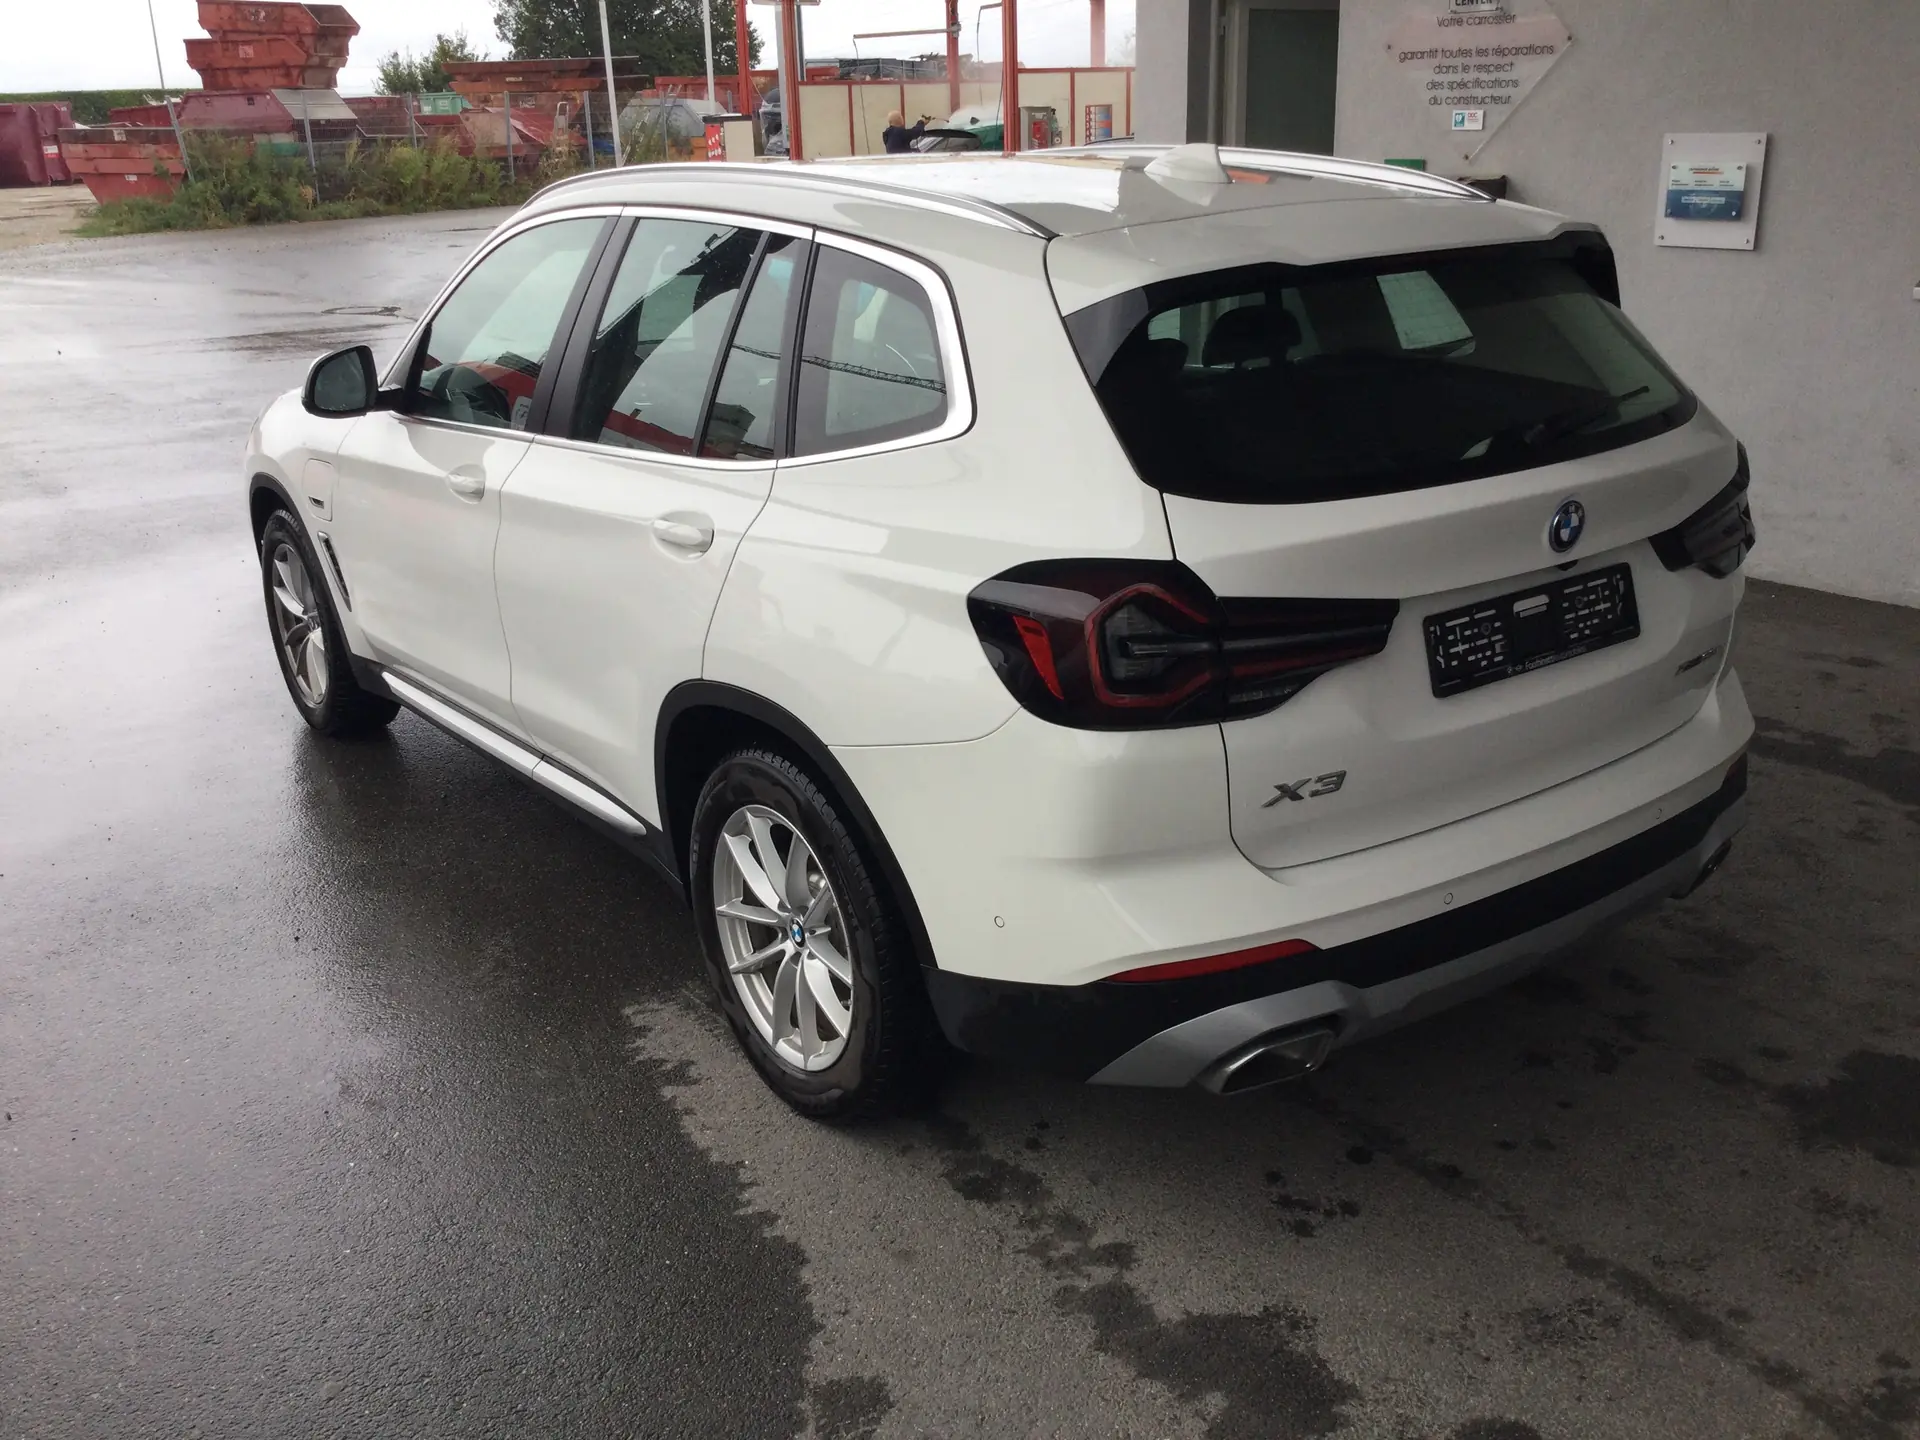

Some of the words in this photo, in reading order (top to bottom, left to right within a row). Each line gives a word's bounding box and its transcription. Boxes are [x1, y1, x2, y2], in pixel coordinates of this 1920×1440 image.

[1436, 16, 1464, 28] Votre
[1465, 12, 1517, 27] carrossier
[1398, 48, 1439, 63] garantit
[1440, 47, 1473, 59] toutes
[1475, 46, 1489, 58] les
[1491, 44, 1554, 58] réparations
[1433, 63, 1459, 75] dans
[1461, 61, 1471, 74] le
[1473, 60, 1514, 75] respect
[1426, 79, 1445, 90] des
[1446, 76, 1520, 92] spécifications
[1428, 95, 1443, 106] du
[1444, 93, 1512, 105] constructeur
[1260, 769, 1347, 808] X3
